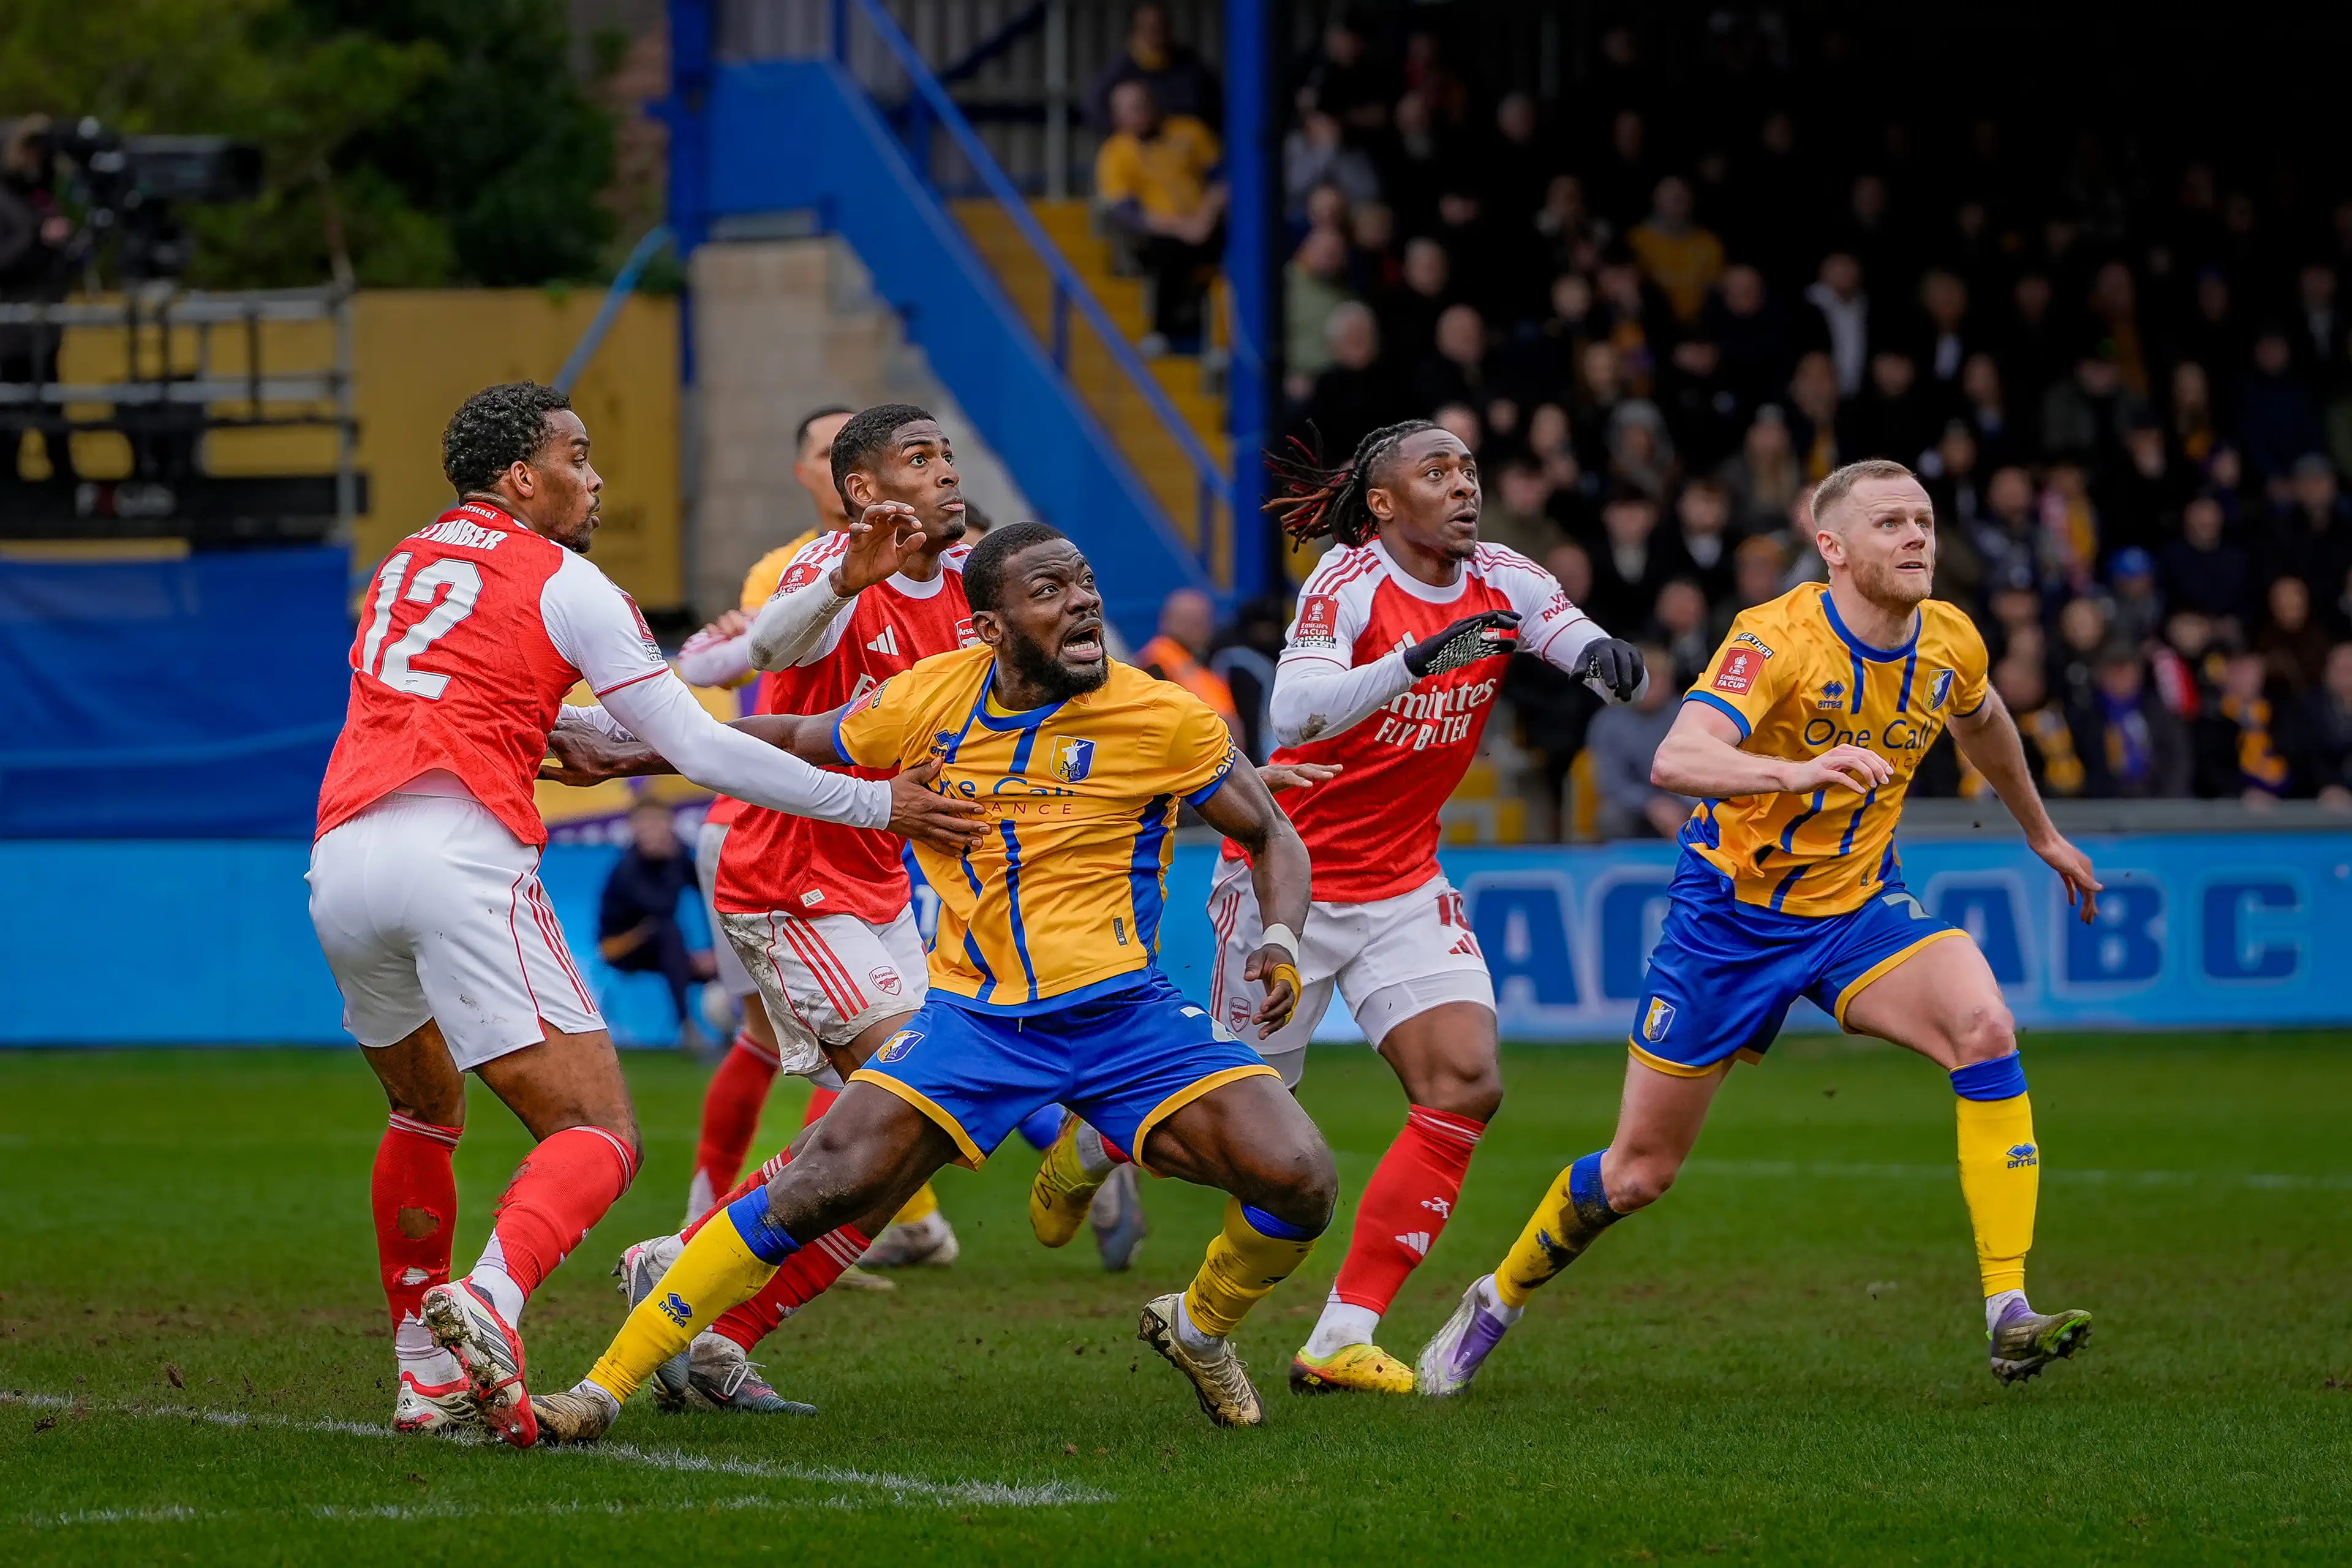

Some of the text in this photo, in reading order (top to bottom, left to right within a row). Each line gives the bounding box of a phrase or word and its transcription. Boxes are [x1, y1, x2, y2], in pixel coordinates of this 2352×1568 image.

[362, 551, 484, 700] 12
[1736, 633, 1773, 658] GETHER
[1719, 674, 1747, 683] Emirates
[1374, 717, 1417, 747] FLY
[1804, 718, 1934, 749] One Call
[991, 801, 1072, 815] ANCE
[658, 1300, 687, 1329] errea
